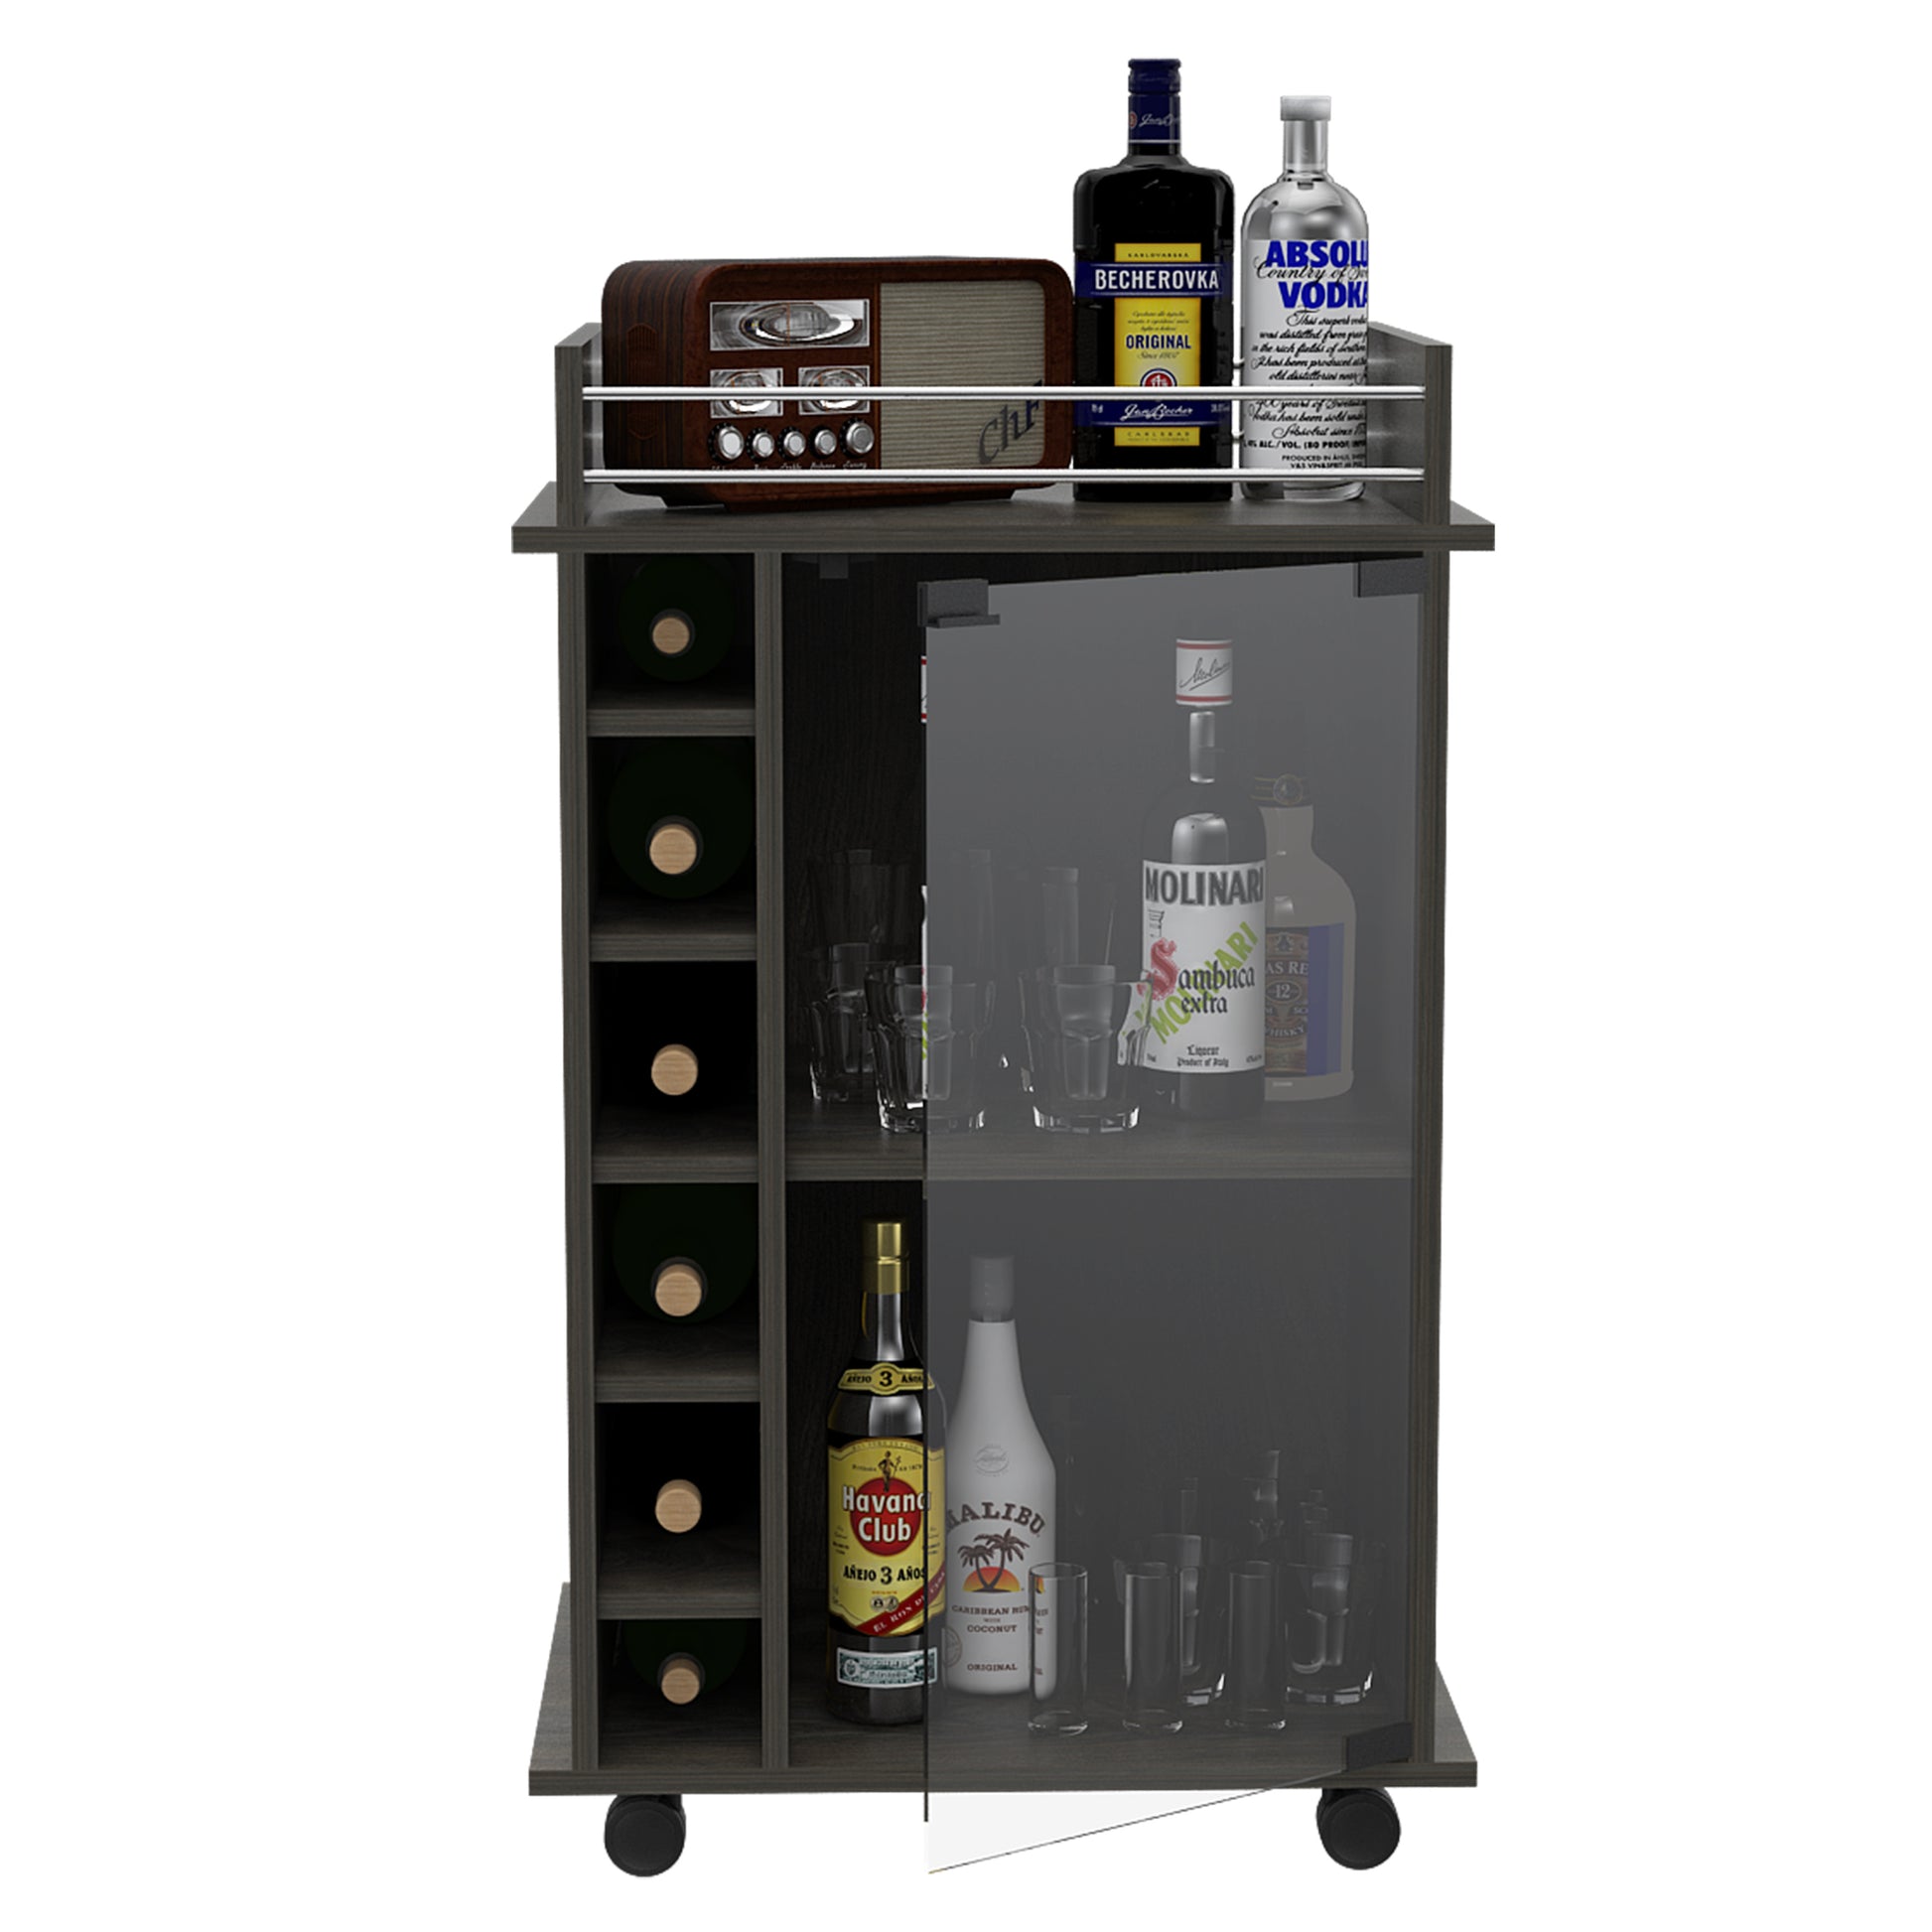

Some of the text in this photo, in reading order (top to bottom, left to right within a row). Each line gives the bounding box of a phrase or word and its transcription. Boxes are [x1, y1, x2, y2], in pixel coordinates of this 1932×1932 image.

[1095, 269, 1219, 290] BECHEROVKA
[1254, 256, 1325, 287] Country
[1126, 335, 1191, 348] ORIGINAL
[1145, 866, 1264, 906] MOLINARI
[1181, 992, 1228, 1014] extra
[880, 1370, 893, 1387] 3
[858, 1517, 911, 1543] Club
[843, 1565, 877, 1582] AÑEJO
[880, 1566, 893, 1586] 3
[951, 1604, 1010, 1616] CARIBBEAN
[967, 1624, 1018, 1633] COCONUT
[967, 1663, 1018, 1672] ORIGINAL
